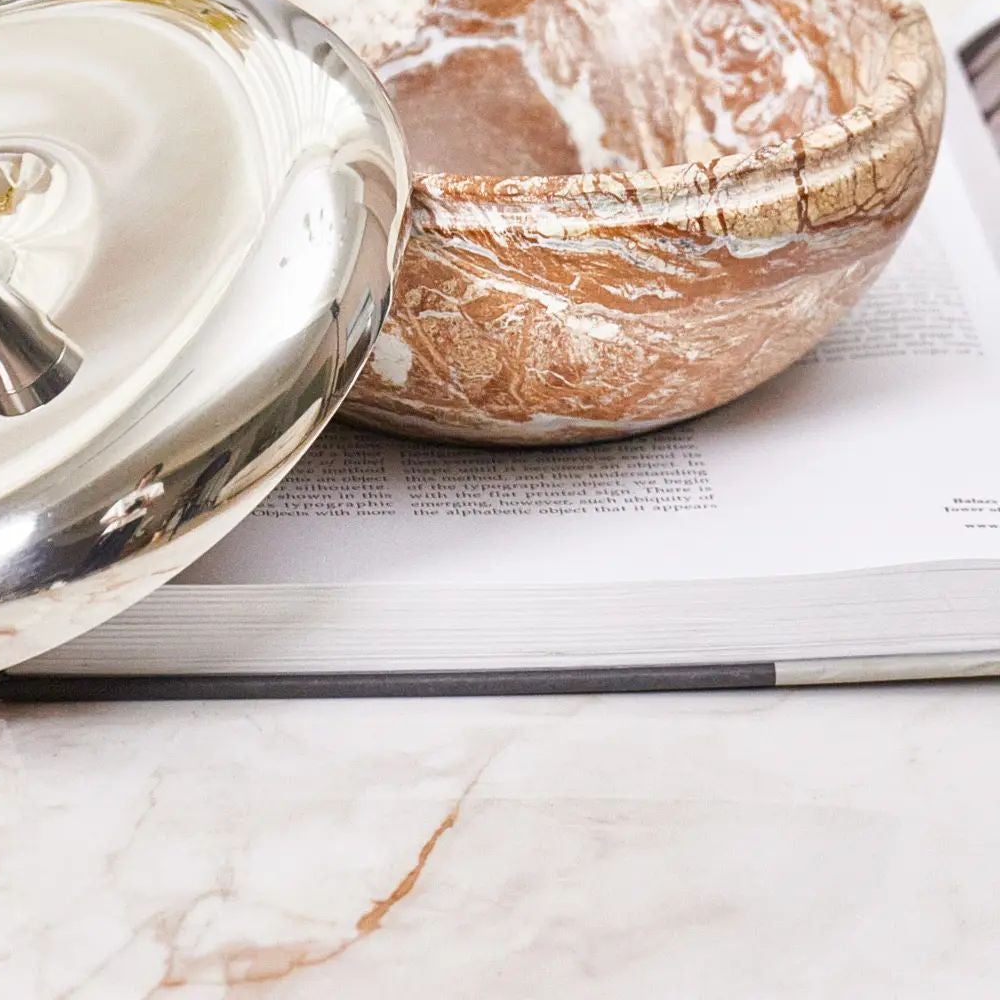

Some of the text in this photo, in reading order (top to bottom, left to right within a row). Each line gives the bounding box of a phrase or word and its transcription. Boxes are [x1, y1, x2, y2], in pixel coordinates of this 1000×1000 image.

[316, 508, 351, 517] with
[357, 508, 397, 517] more
[414, 508, 440, 517] the
[538, 505, 587, 516] object
[595, 504, 626, 514] that
